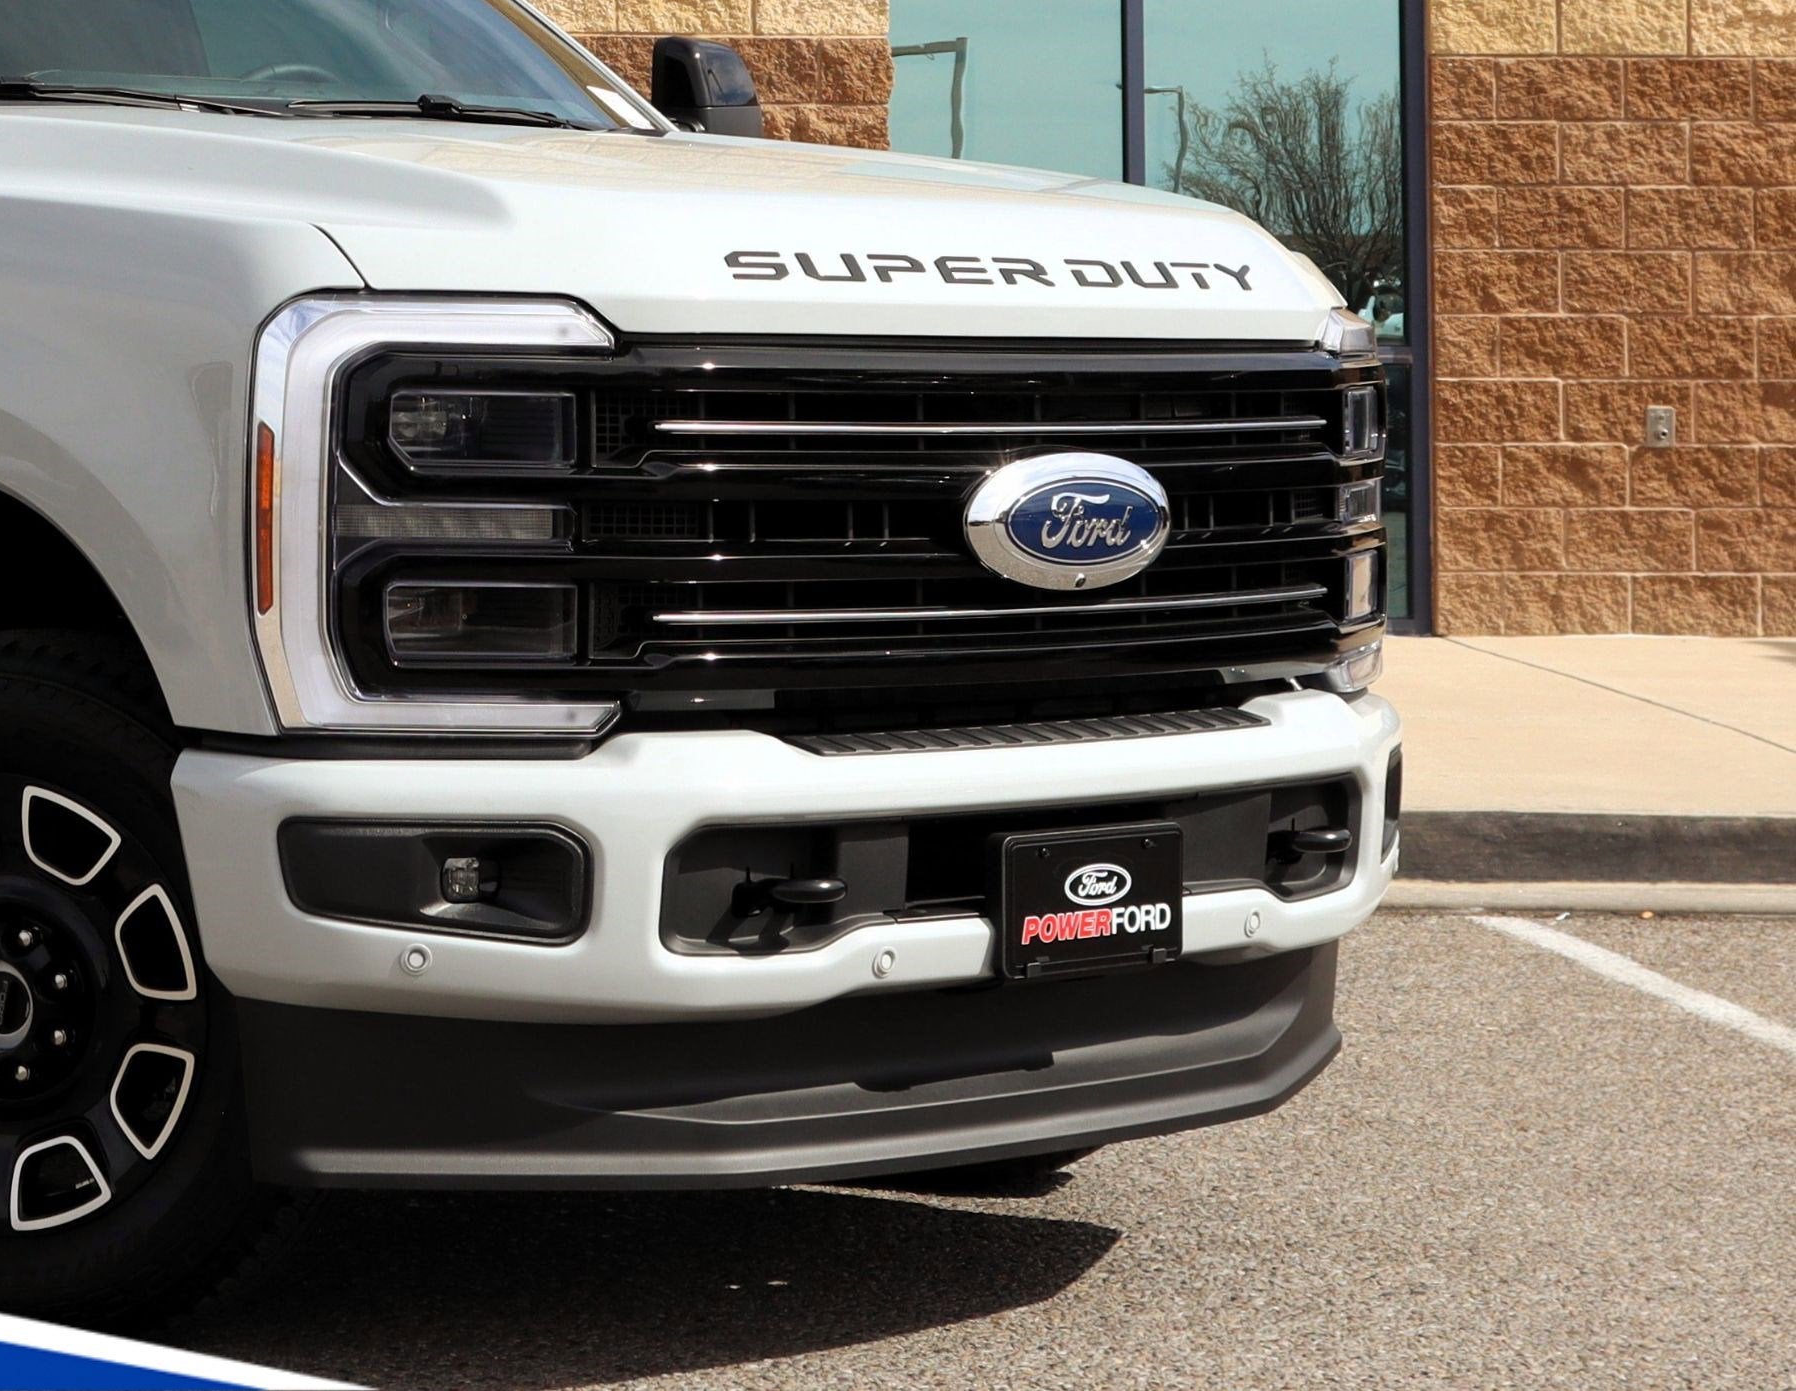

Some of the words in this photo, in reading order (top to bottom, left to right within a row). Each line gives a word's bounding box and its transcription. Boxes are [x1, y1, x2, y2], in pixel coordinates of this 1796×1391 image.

[723, 250, 1056, 287] SUPER
[1063, 258, 1253, 292] DUTY
[1041, 491, 1134, 549] Ford
[1077, 871, 1118, 898] Ford
[1020, 902, 1172, 946] POWERFORD
